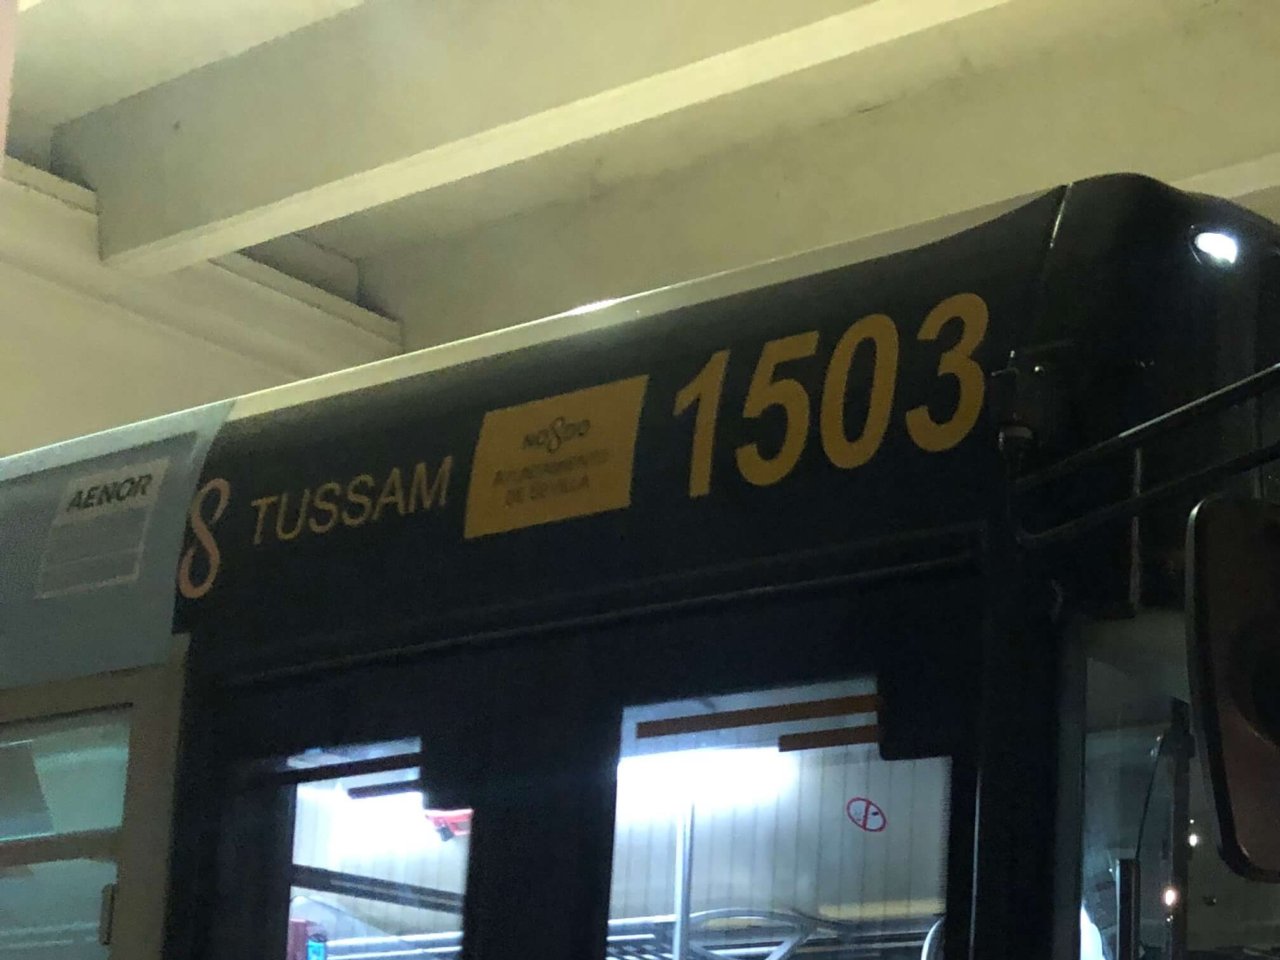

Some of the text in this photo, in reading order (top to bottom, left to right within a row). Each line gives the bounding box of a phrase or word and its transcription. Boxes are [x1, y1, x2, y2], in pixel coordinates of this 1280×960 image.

[672, 293, 989, 499] 1503
[66, 474, 152, 512] AENOR
[251, 455, 452, 544] TUSSAM
